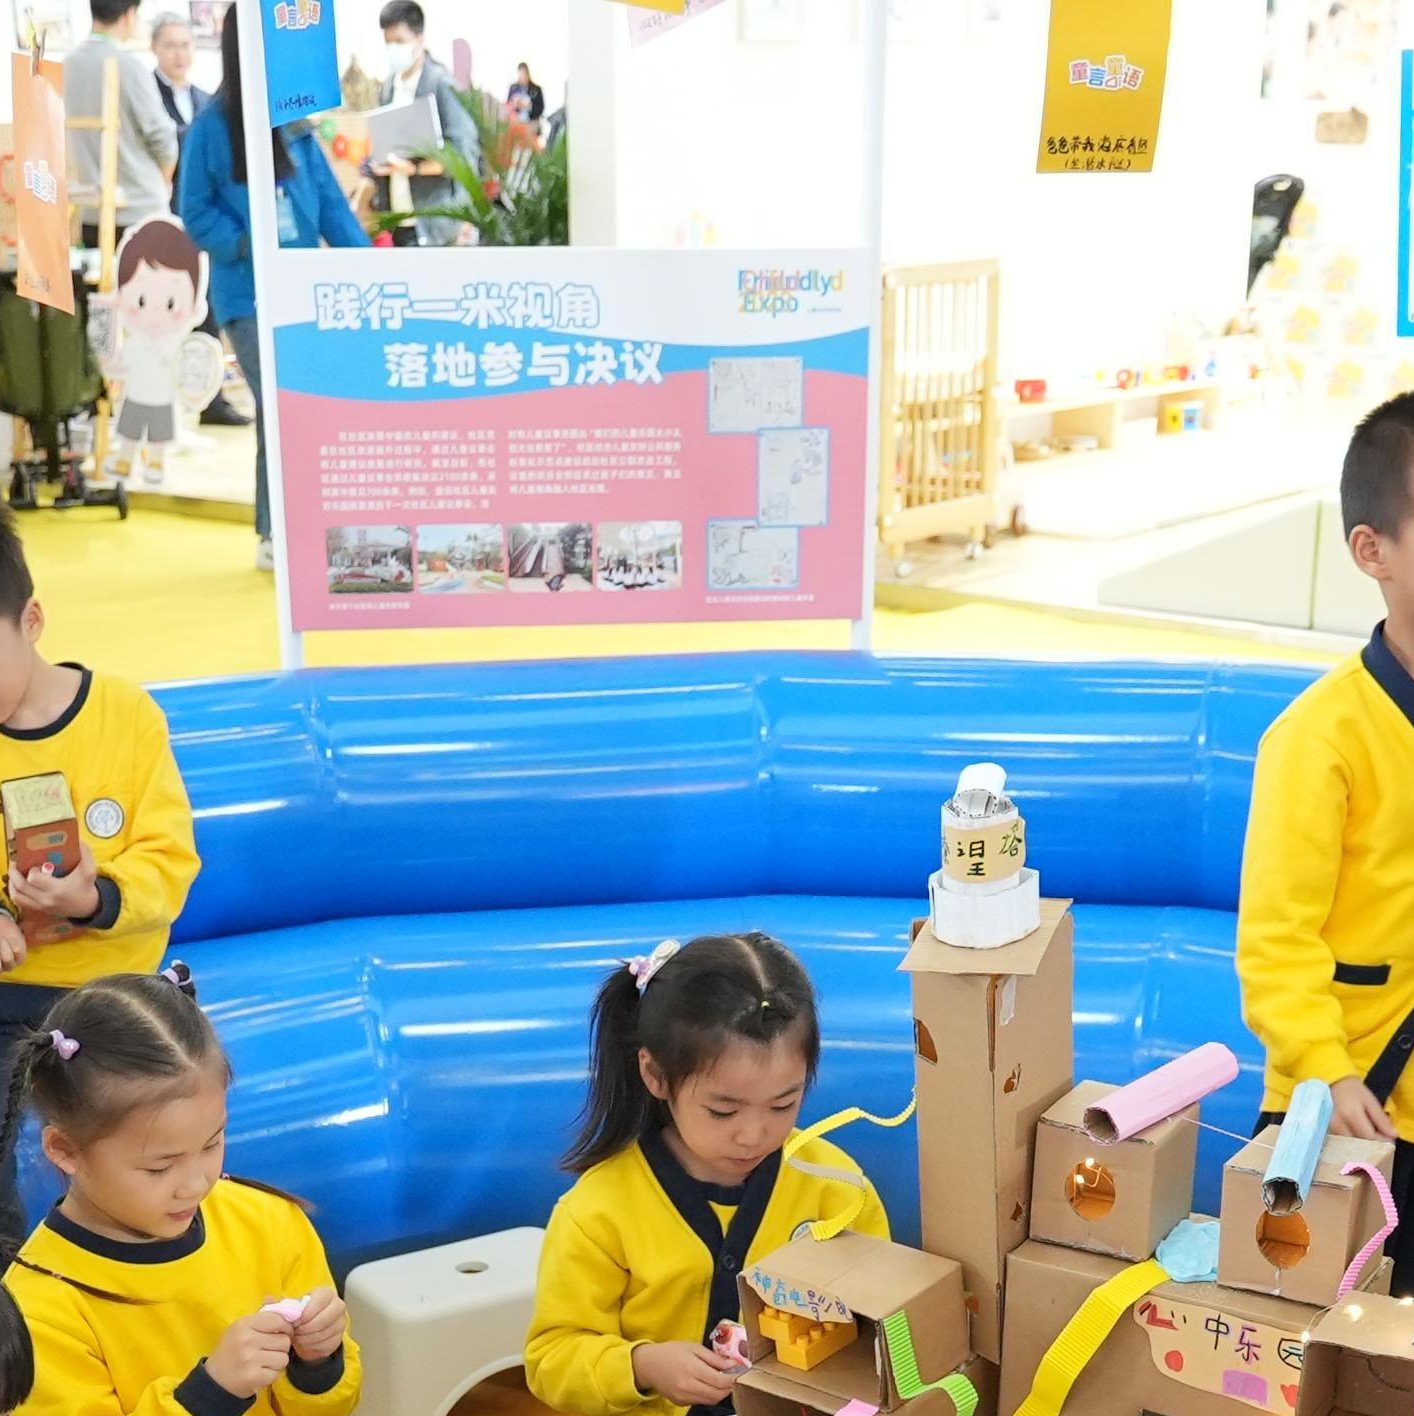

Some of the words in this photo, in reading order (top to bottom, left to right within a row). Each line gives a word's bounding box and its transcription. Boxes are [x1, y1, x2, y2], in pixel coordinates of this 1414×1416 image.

[314, 282, 601, 331] 践行一米视角
[383, 341, 666, 388] 落地参与决议
[1138, 1300, 1305, 1370] 心中乐园
